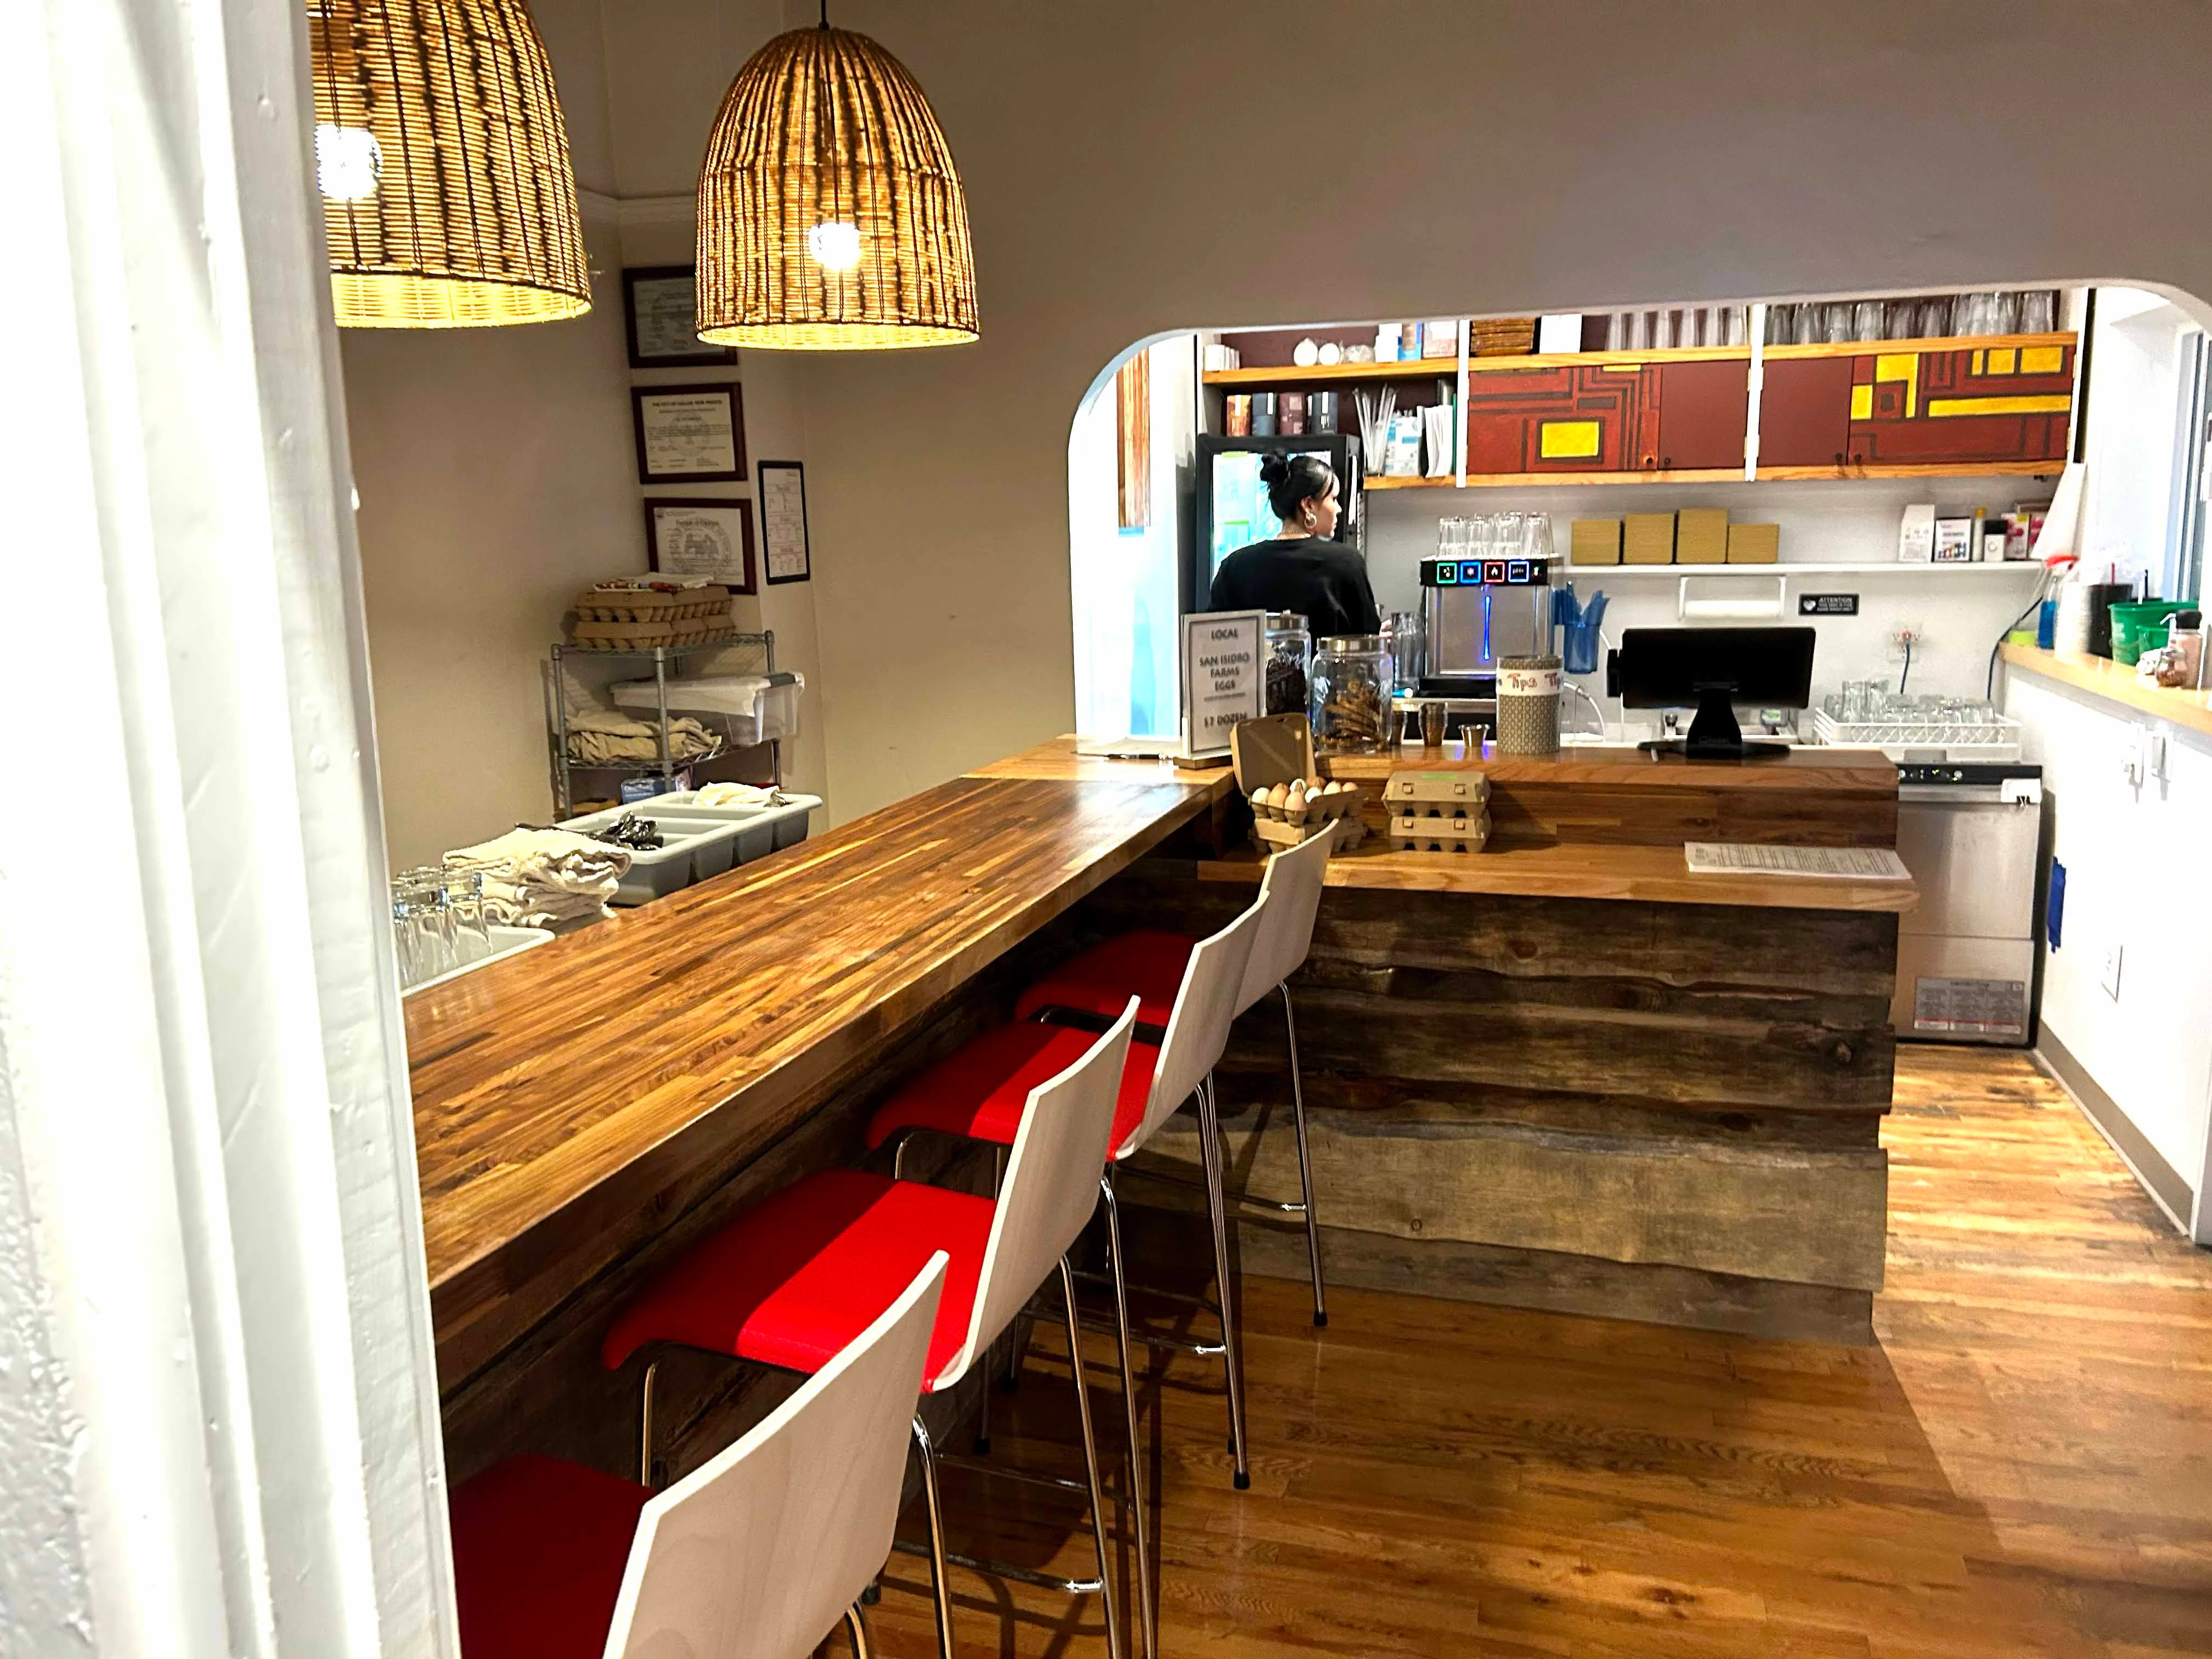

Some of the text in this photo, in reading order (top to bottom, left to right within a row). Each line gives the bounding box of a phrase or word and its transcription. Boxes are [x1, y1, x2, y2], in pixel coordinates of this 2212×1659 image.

[1211, 628, 1238, 641] LOCAL
[1199, 652, 1250, 667] SAN ISIDRO
[1210, 667, 1239, 678] FARMS
[1215, 680, 1235, 691] EGGS
[1507, 672, 1563, 691] Tips Tip
[1217, 711, 1247, 725] DOZEN
